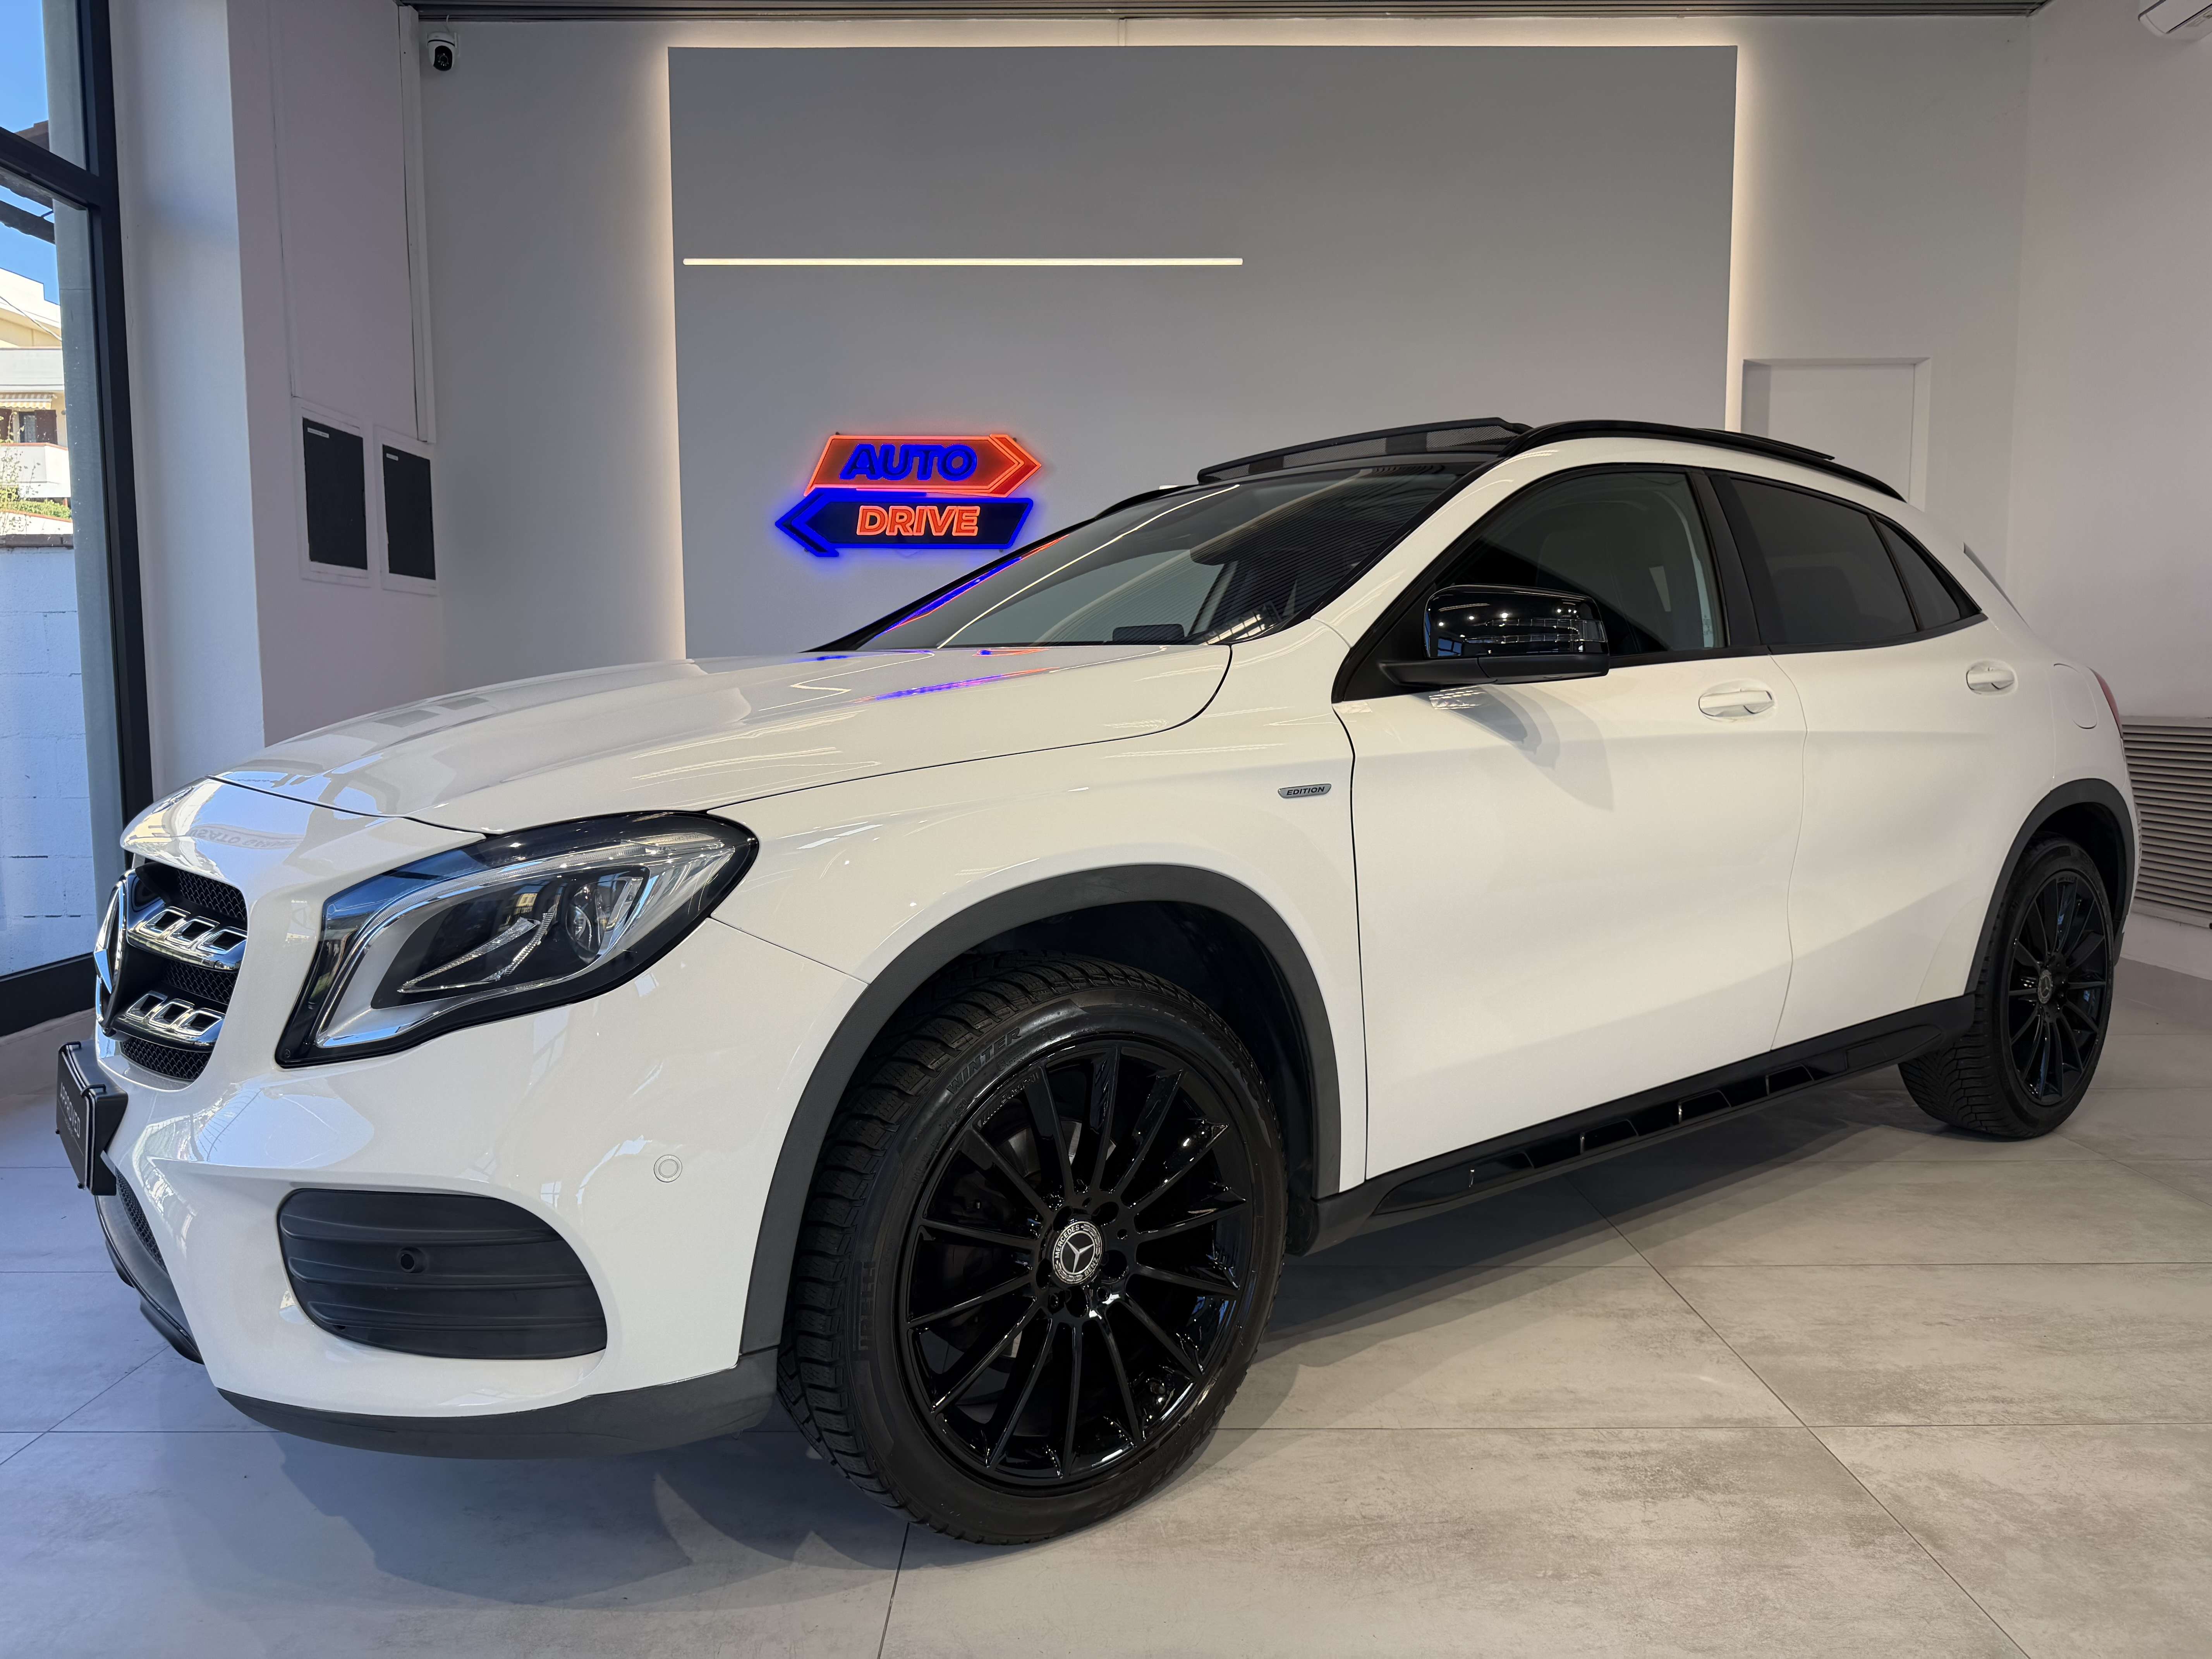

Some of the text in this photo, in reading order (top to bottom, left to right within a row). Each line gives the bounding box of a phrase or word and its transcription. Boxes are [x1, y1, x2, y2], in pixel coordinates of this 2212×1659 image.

[839, 444, 977, 481] AUTO
[856, 505, 980, 536] DRIVE
[1286, 787, 1325, 795] EDITION
[946, 1027, 1022, 1094] WINTER
[1055, 1224, 1080, 1258] MERCEDES
[1085, 1257, 1098, 1276] BENZ
